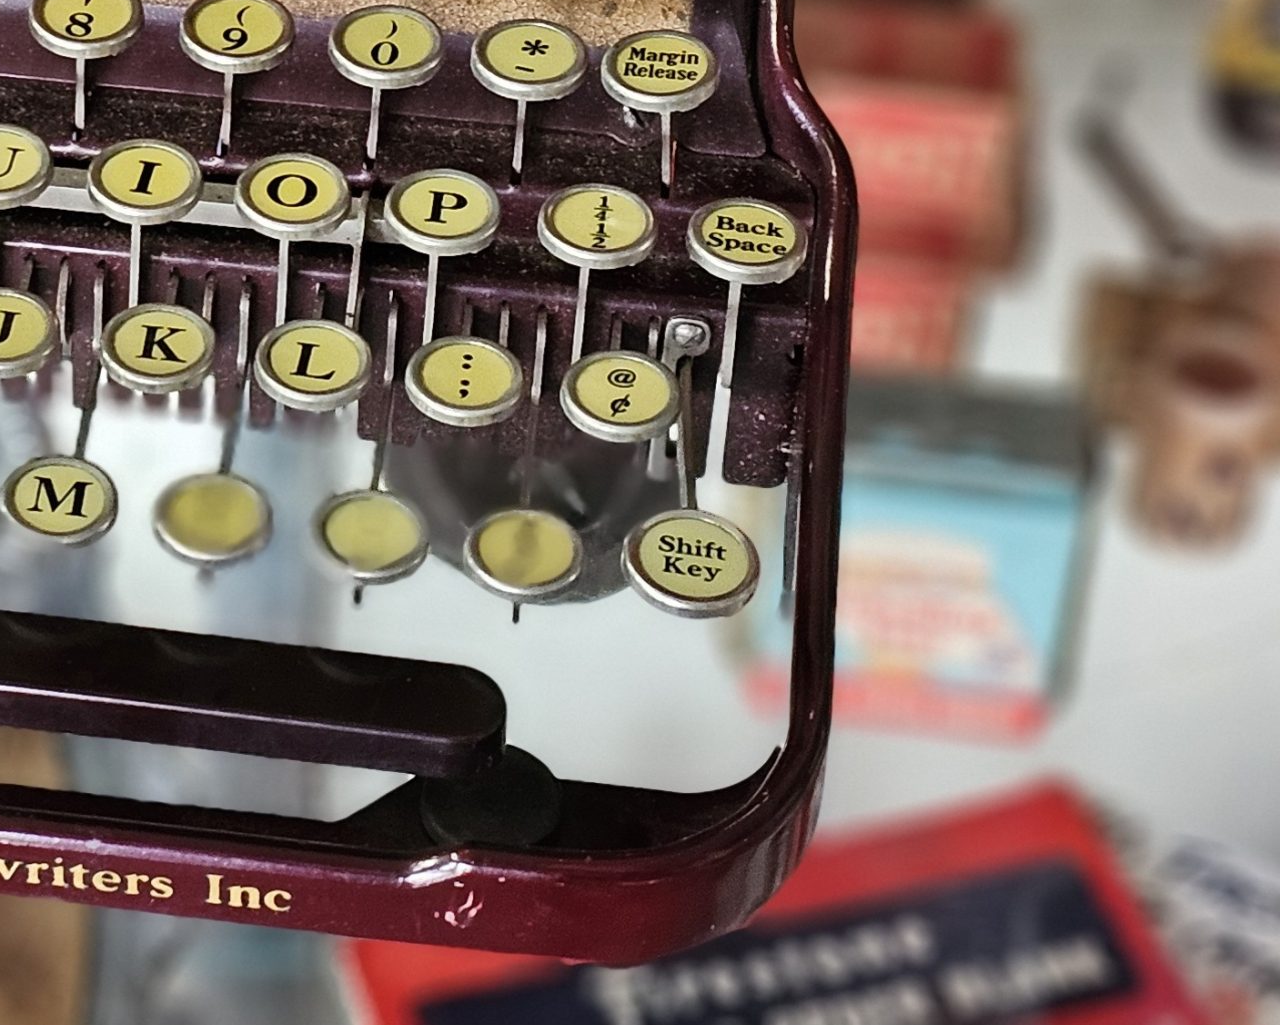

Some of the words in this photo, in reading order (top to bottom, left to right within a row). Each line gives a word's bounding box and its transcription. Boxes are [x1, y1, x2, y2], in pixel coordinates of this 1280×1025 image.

[64, 12, 94, 38] 8
[221, 27, 249, 51] 9
[370, 41, 400, 66] 0
[628, 46, 700, 67] Margin
[622, 62, 700, 82] Release
[129, 160, 162, 195] I
[266, 173, 318, 208] O
[424, 190, 468, 224] P
[715, 214, 785, 239] Back
[706, 231, 788, 257] Space
[135, 324, 187, 364] K
[289, 341, 336, 381] L
[607, 368, 637, 389] @
[26, 475, 94, 518] M
[657, 533, 728, 561] Shift
[662, 555, 724, 584] Key
[204, 873, 293, 913] Inc
